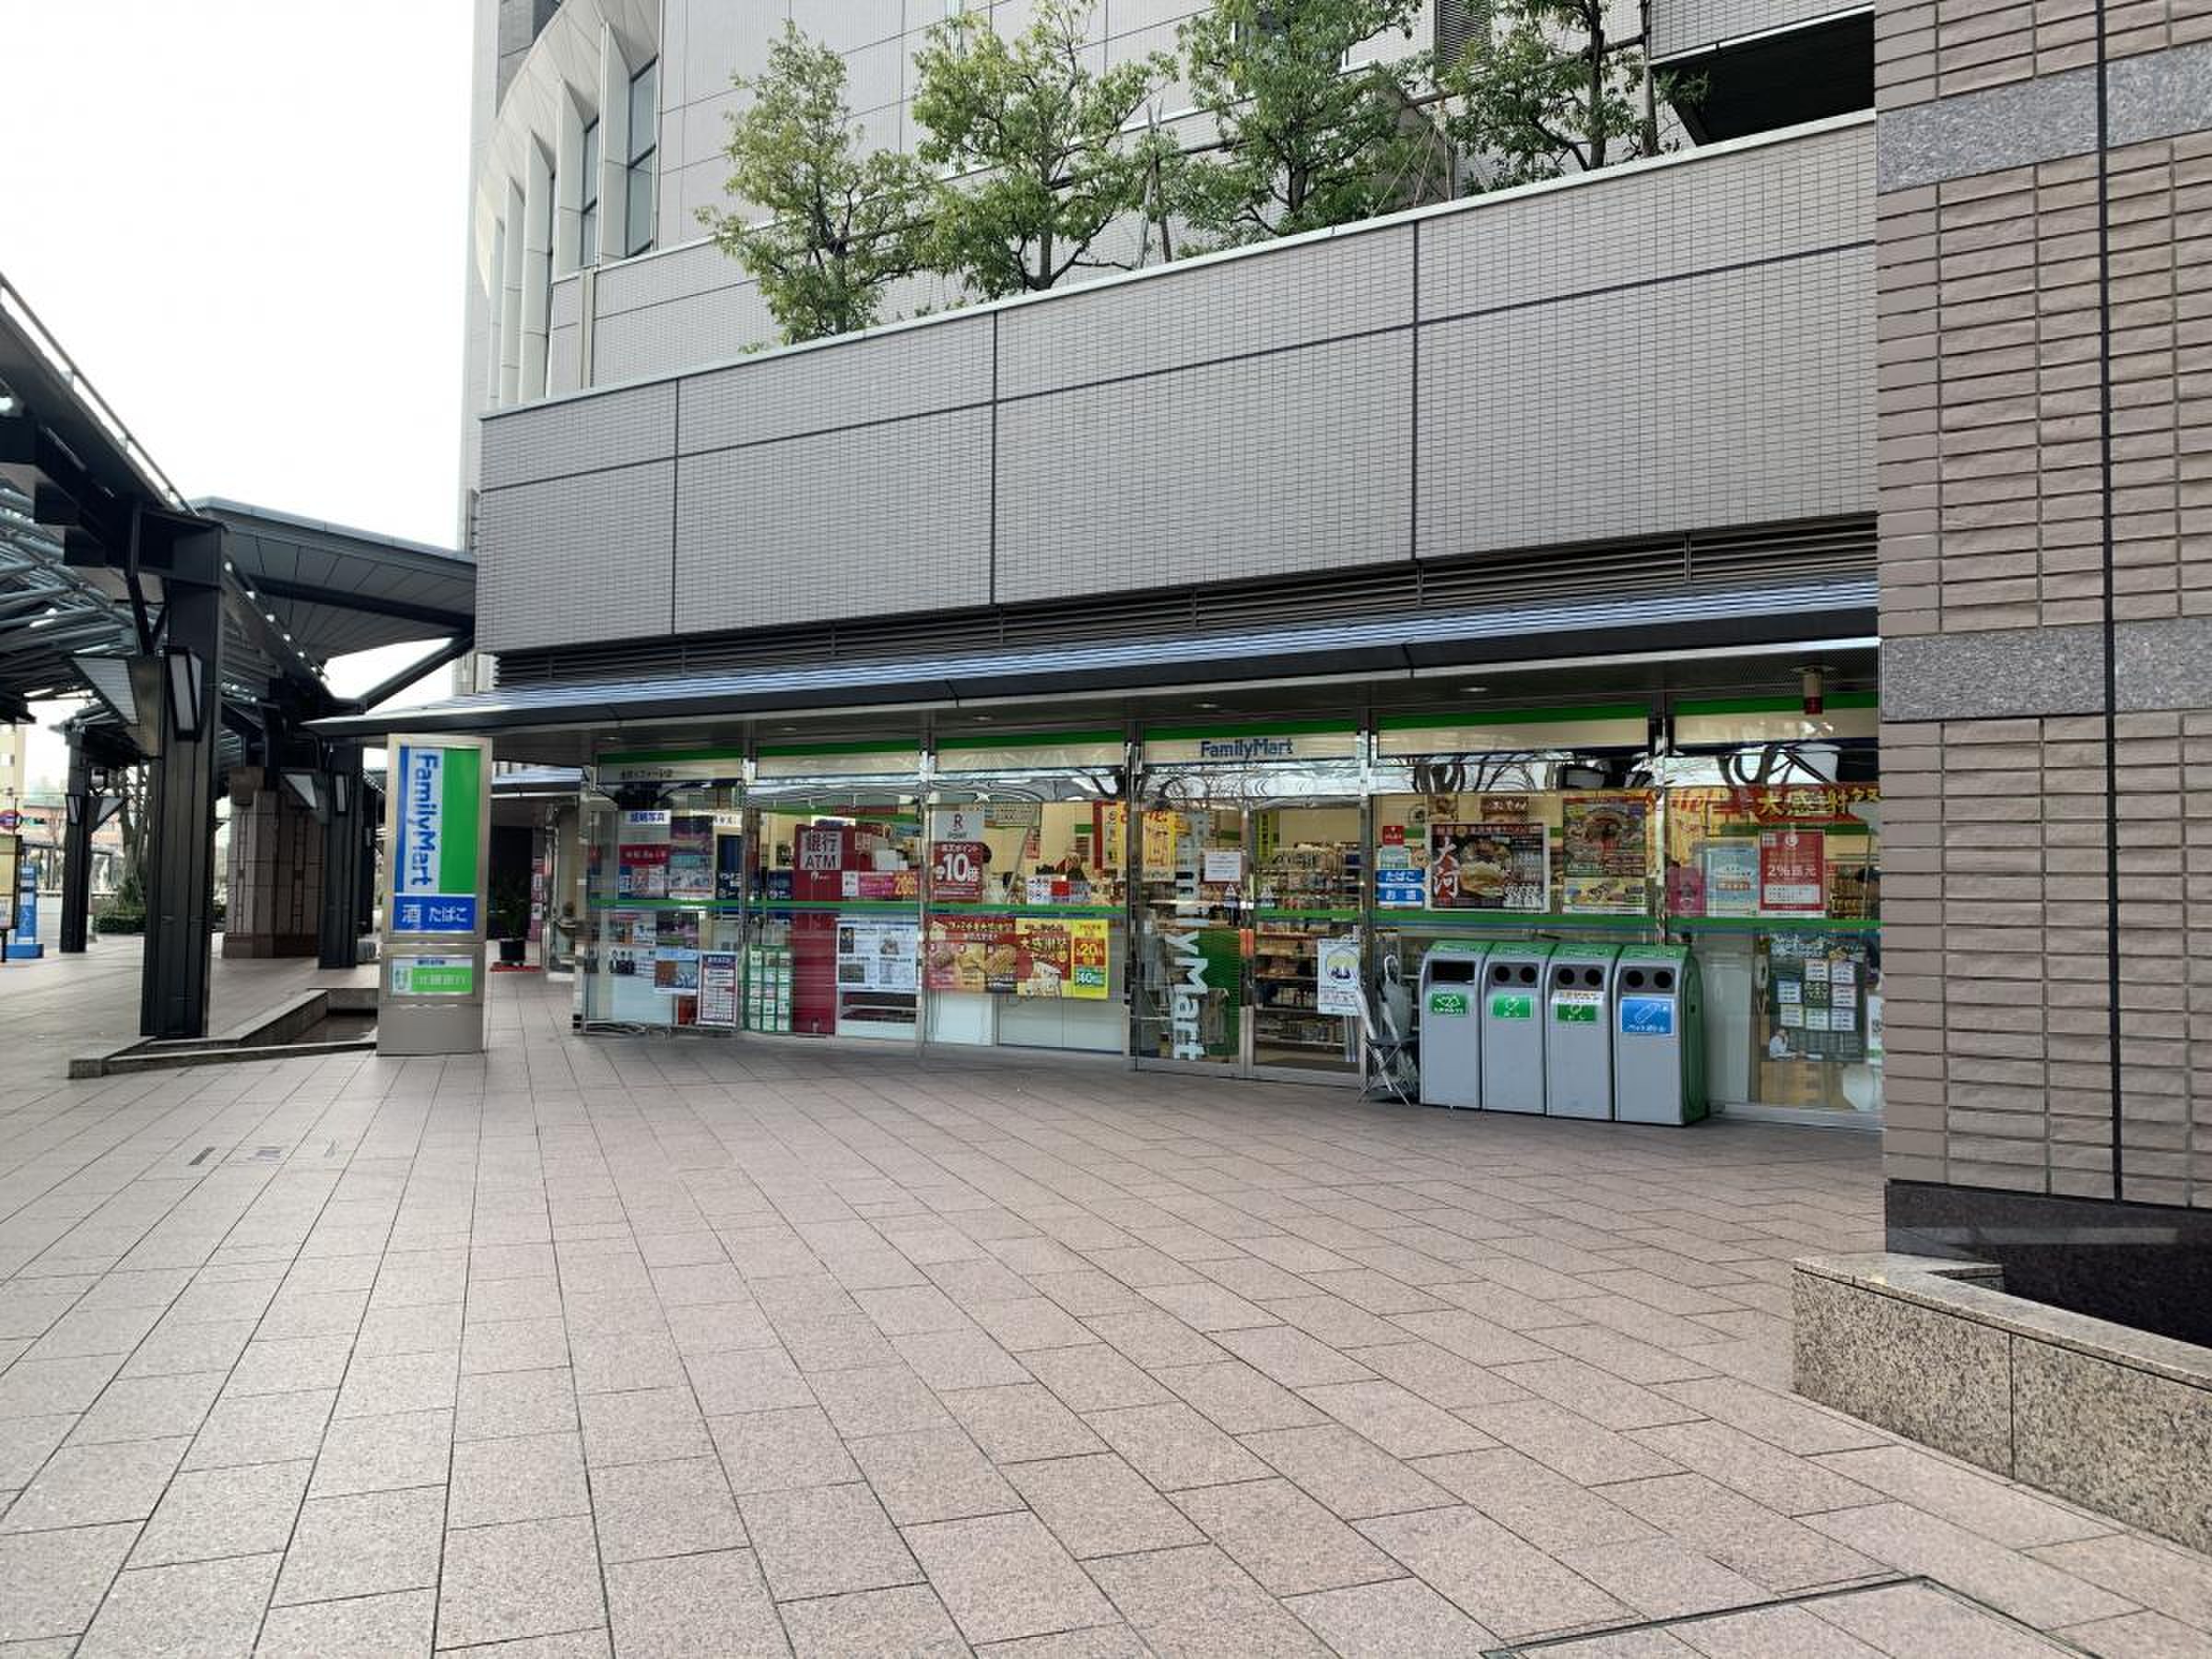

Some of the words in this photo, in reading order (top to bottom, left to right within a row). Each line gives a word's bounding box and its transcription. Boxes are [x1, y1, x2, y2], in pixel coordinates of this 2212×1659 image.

[1201, 739, 1293, 759] FamilyMart
[407, 753, 438, 886] FamilyMart
[805, 855, 836, 869] ATM
[1432, 835, 1461, 900] 大河
[1385, 870, 1418, 882] たばこ
[401, 904, 422, 924] 酒
[428, 906, 468, 924] たばこ
